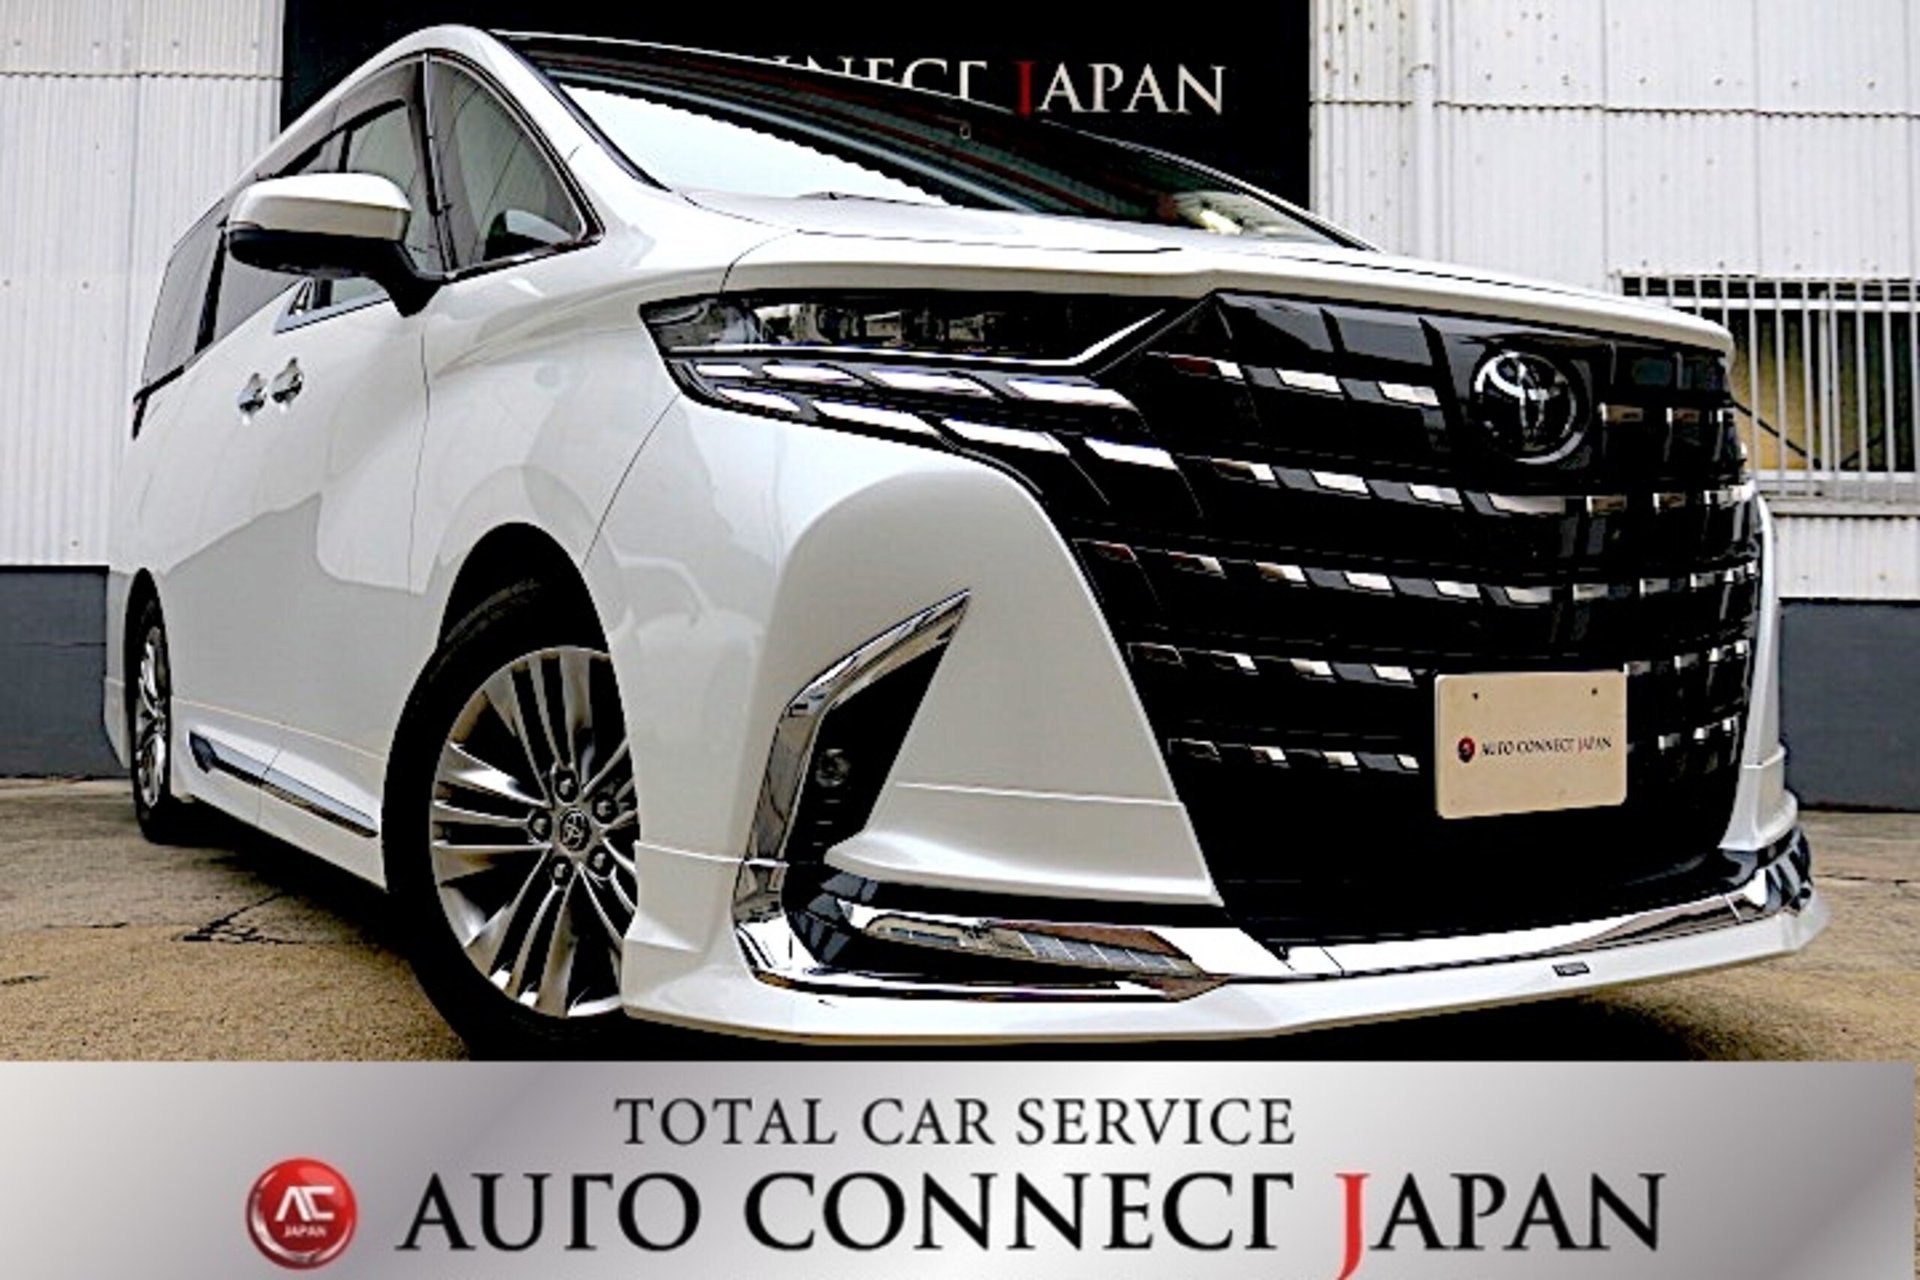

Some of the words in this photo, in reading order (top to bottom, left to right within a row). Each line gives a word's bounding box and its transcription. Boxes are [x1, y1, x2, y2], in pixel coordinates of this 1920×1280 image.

[1012, 60, 1229, 117] JAPAN
[1516, 737, 1575, 754] CONNECT
[1578, 735, 1612, 754] JAPAN
